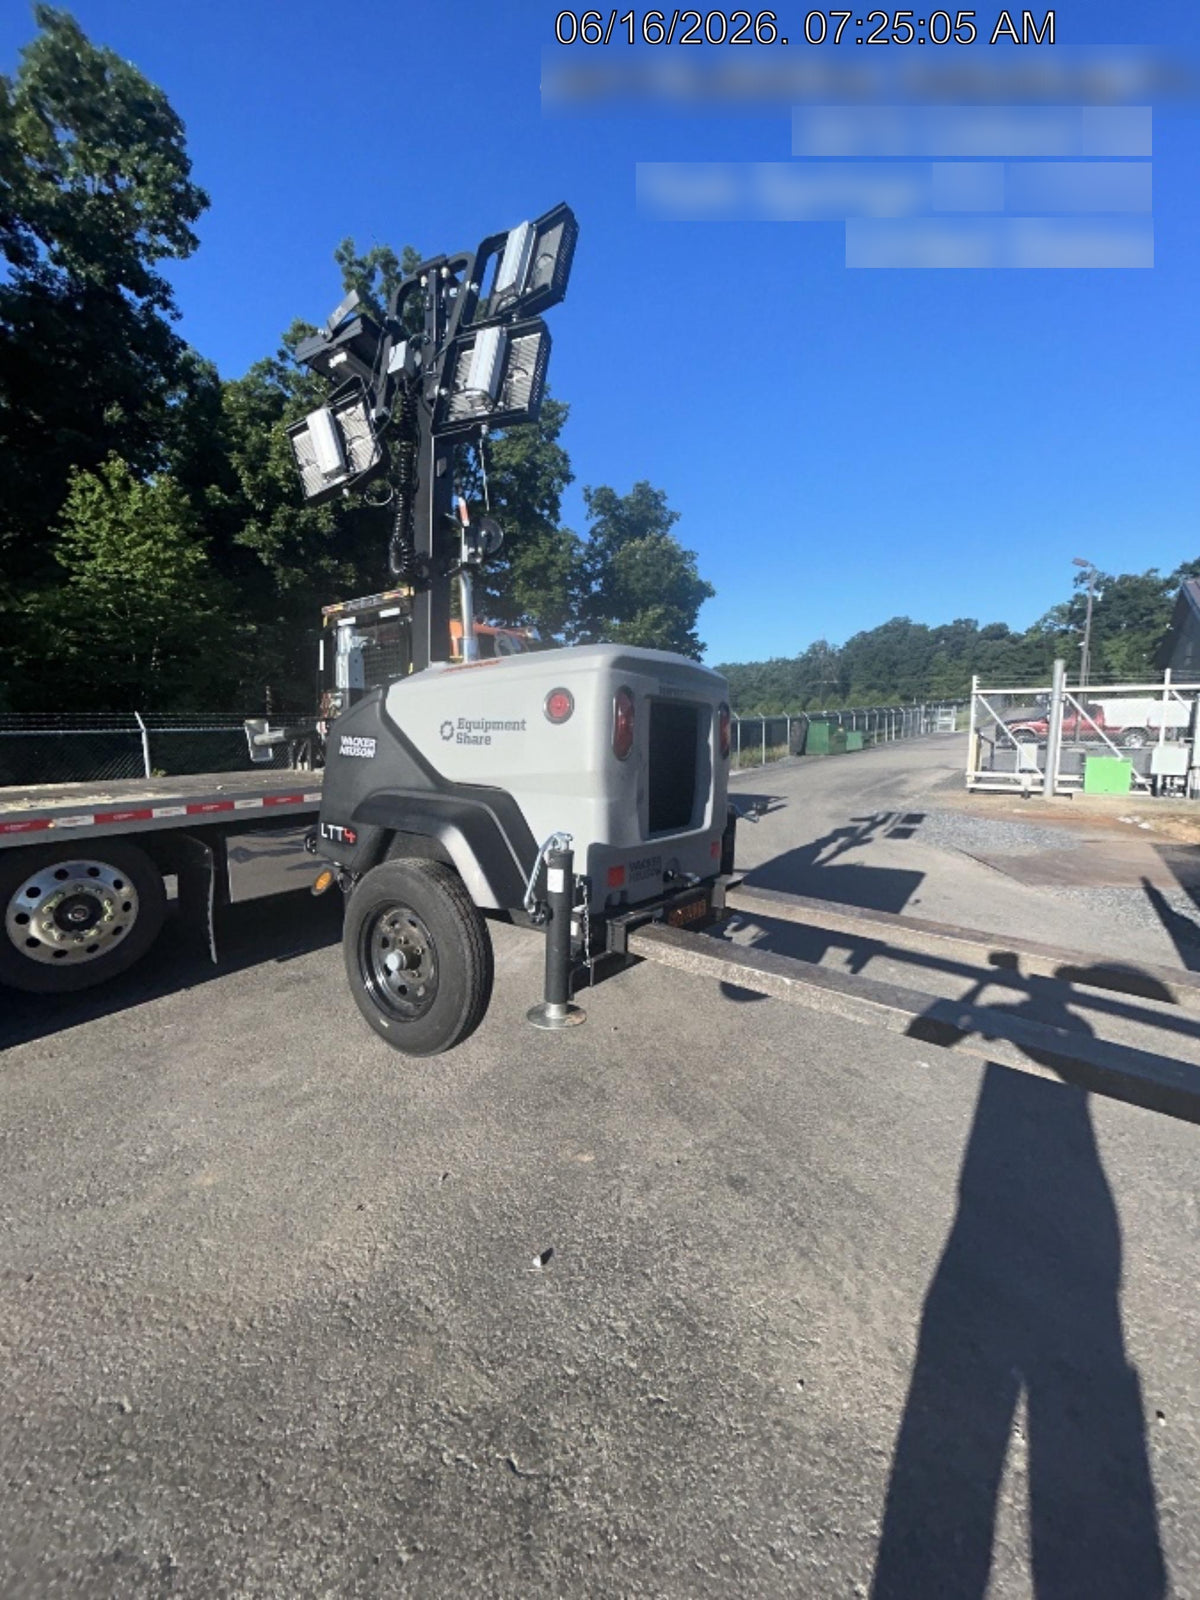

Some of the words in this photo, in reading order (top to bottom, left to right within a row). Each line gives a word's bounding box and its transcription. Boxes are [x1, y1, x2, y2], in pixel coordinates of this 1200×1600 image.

[456, 717, 527, 733] Equipment
[340, 735, 376, 748] WACKER
[456, 732, 492, 746] Share
[339, 744, 376, 758] NEUSON
[320, 822, 356, 844] LTT4
